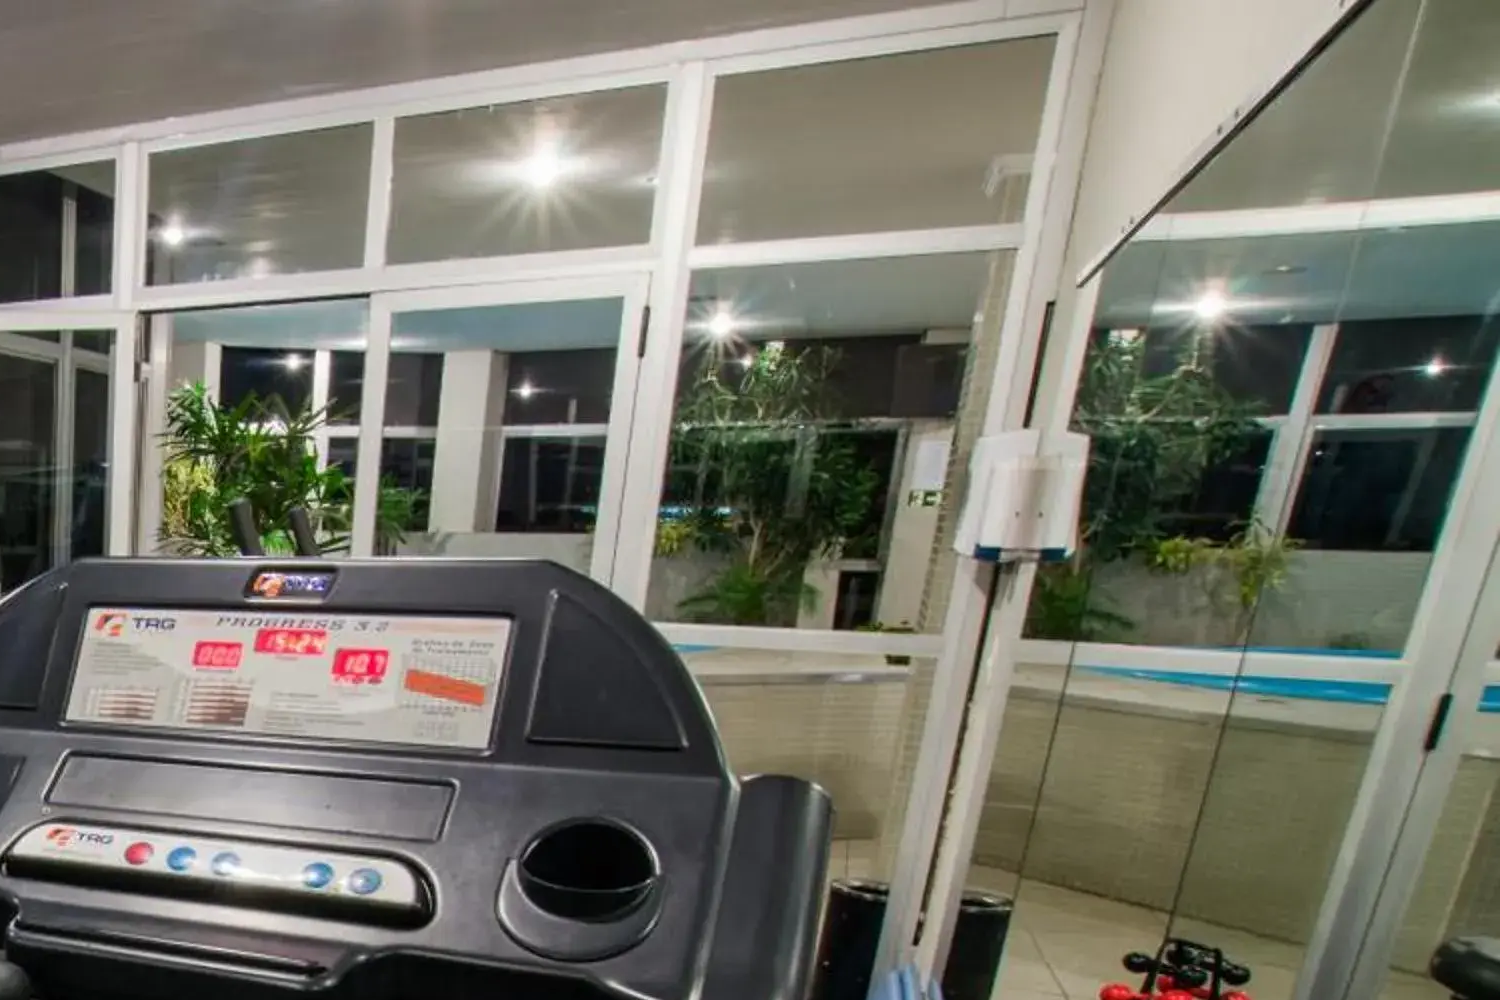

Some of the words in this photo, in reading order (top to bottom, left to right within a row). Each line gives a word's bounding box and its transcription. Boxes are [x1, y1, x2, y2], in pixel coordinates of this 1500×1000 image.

[132, 617, 177, 631] TRG
[216, 615, 346, 631] PROGRESS
[79, 832, 114, 845] TRG
